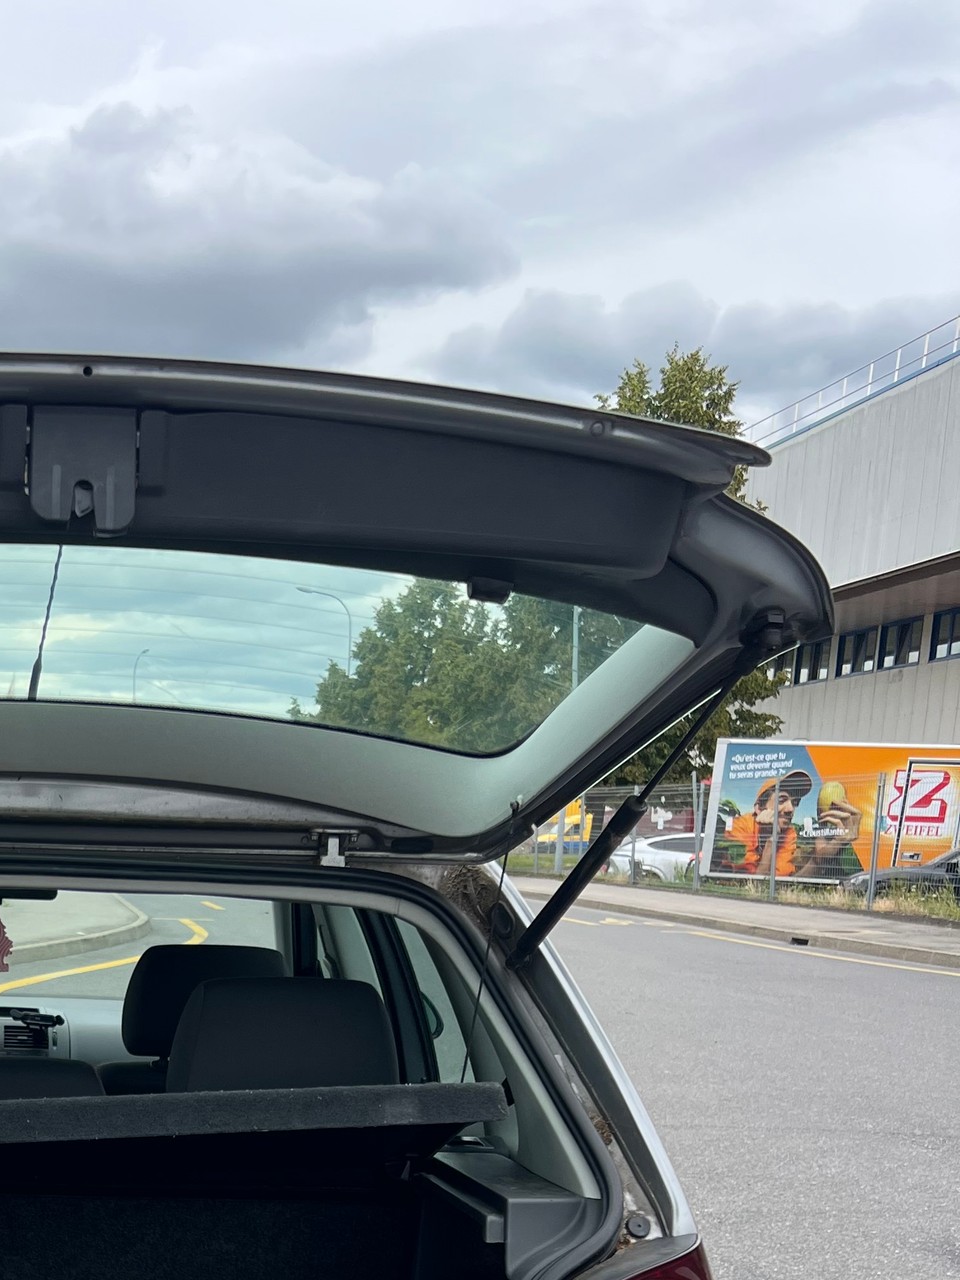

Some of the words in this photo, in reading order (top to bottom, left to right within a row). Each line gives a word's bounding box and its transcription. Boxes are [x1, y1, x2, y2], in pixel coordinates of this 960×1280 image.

[765, 753, 778, 761] que
[779, 752, 787, 760] tu
[746, 762, 771, 770] devenir
[771, 759, 793, 769] quand
[729, 771, 737, 779] tu
[754, 769, 778, 778] grande
